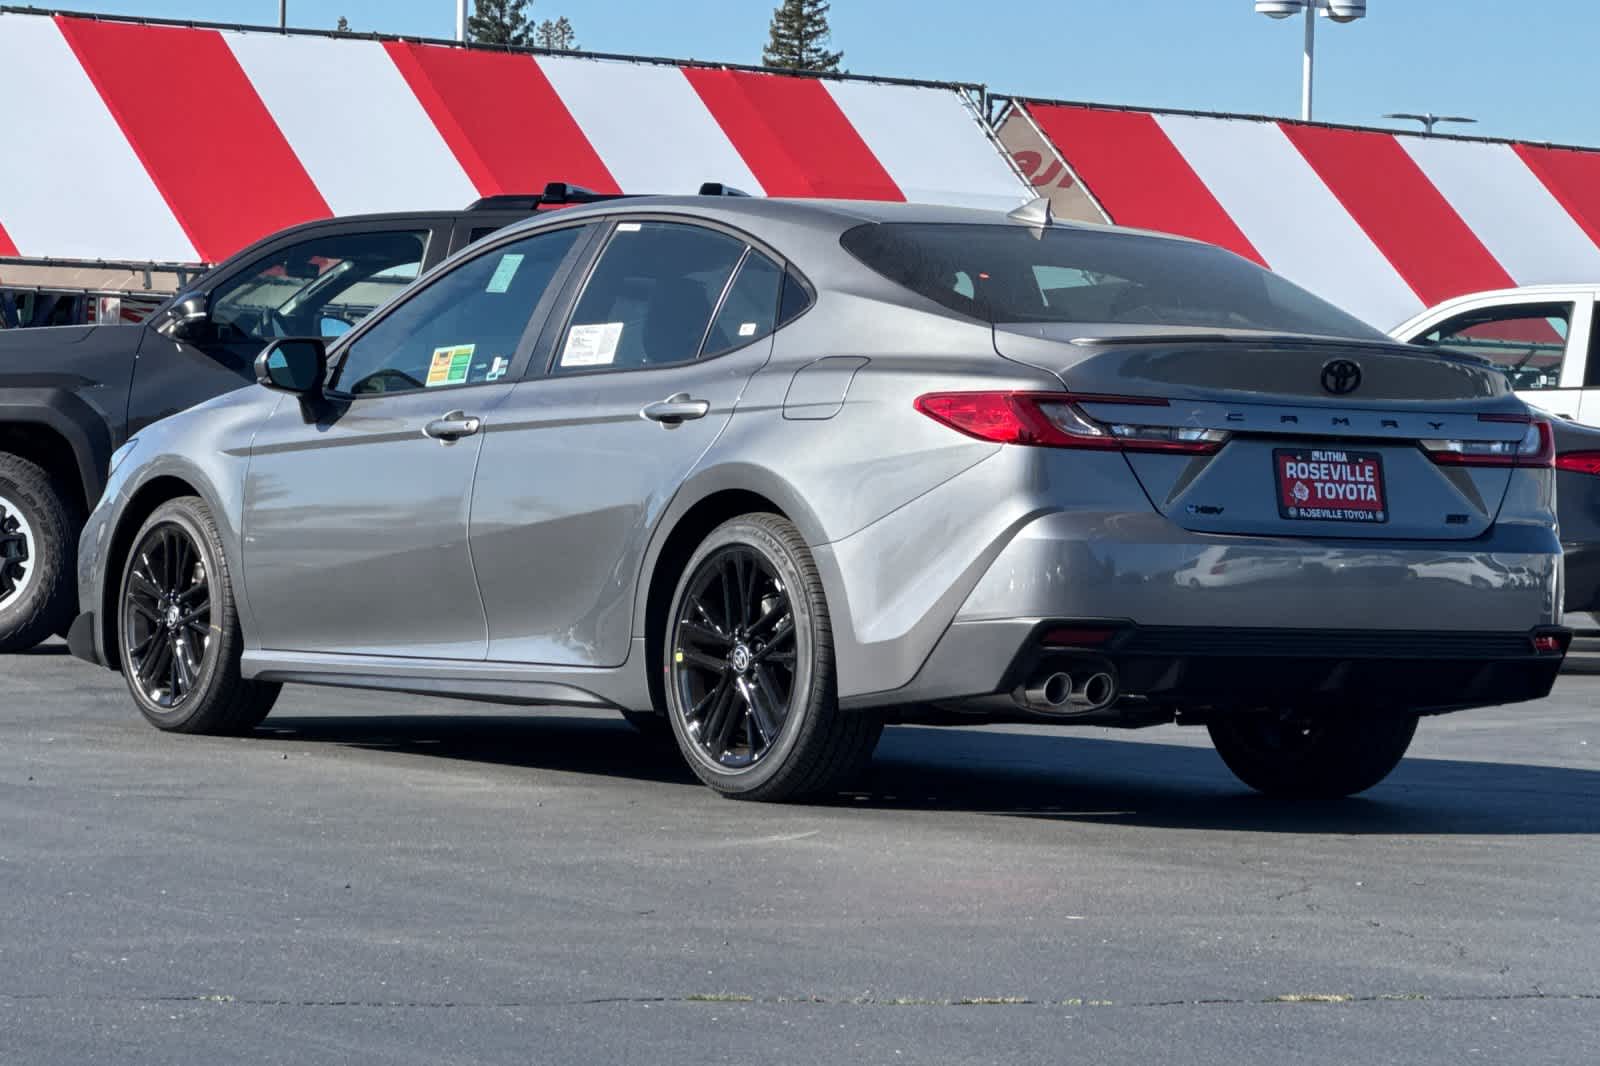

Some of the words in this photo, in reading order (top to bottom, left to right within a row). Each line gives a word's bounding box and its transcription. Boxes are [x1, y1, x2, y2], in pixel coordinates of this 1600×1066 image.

[1225, 412, 1446, 431] CAMRY
[1320, 451, 1348, 463] LITHIA
[1286, 462, 1375, 482] ROSEVILLE
[1314, 481, 1377, 502] TOYOTA
[1300, 508, 1343, 519] ROSEVILLE
[1344, 510, 1374, 520] TOYOTA
